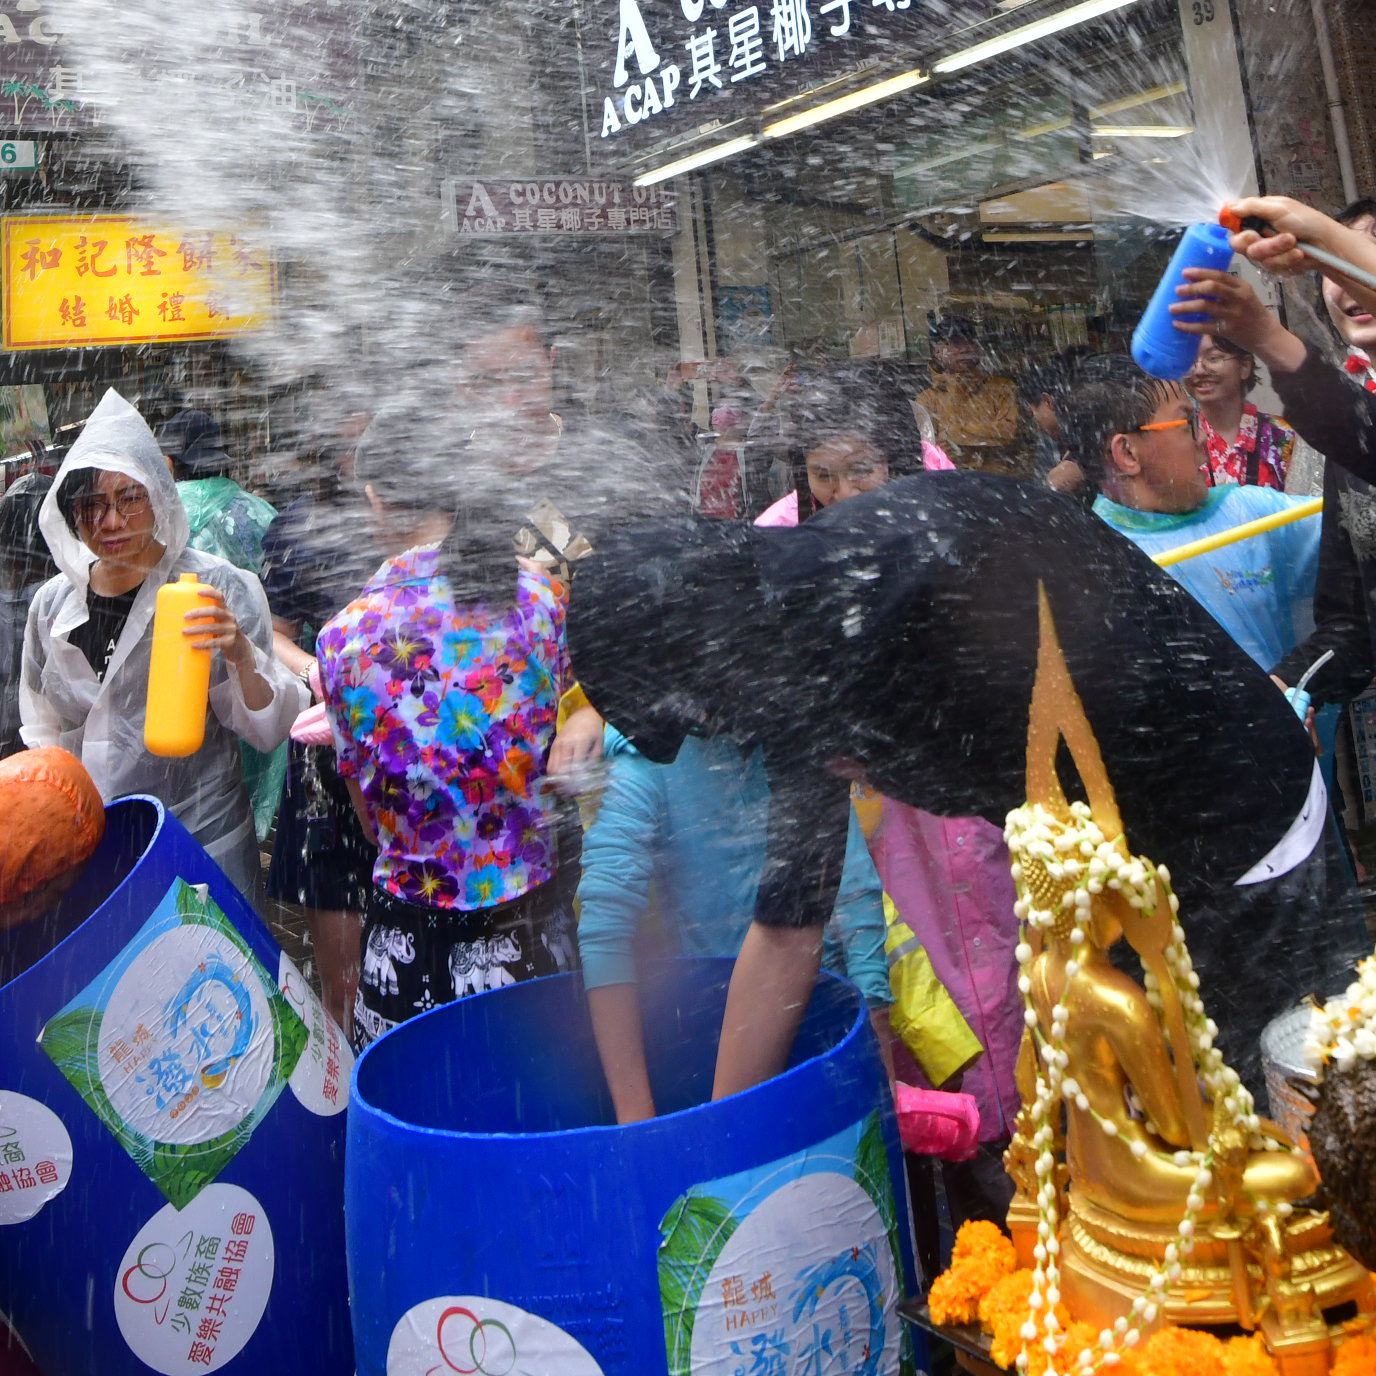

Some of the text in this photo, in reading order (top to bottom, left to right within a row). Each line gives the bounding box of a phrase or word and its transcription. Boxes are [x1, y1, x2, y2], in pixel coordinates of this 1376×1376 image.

[465, 183, 499, 217] A
[509, 182, 623, 204] COCONUT
[512, 207, 673, 231] 其星椰子專門店
[170, 1235, 221, 1334] 少數族裔
[187, 1211, 256, 1366] 愛樂共融協會
[725, 1303, 779, 1331] HAPPY
